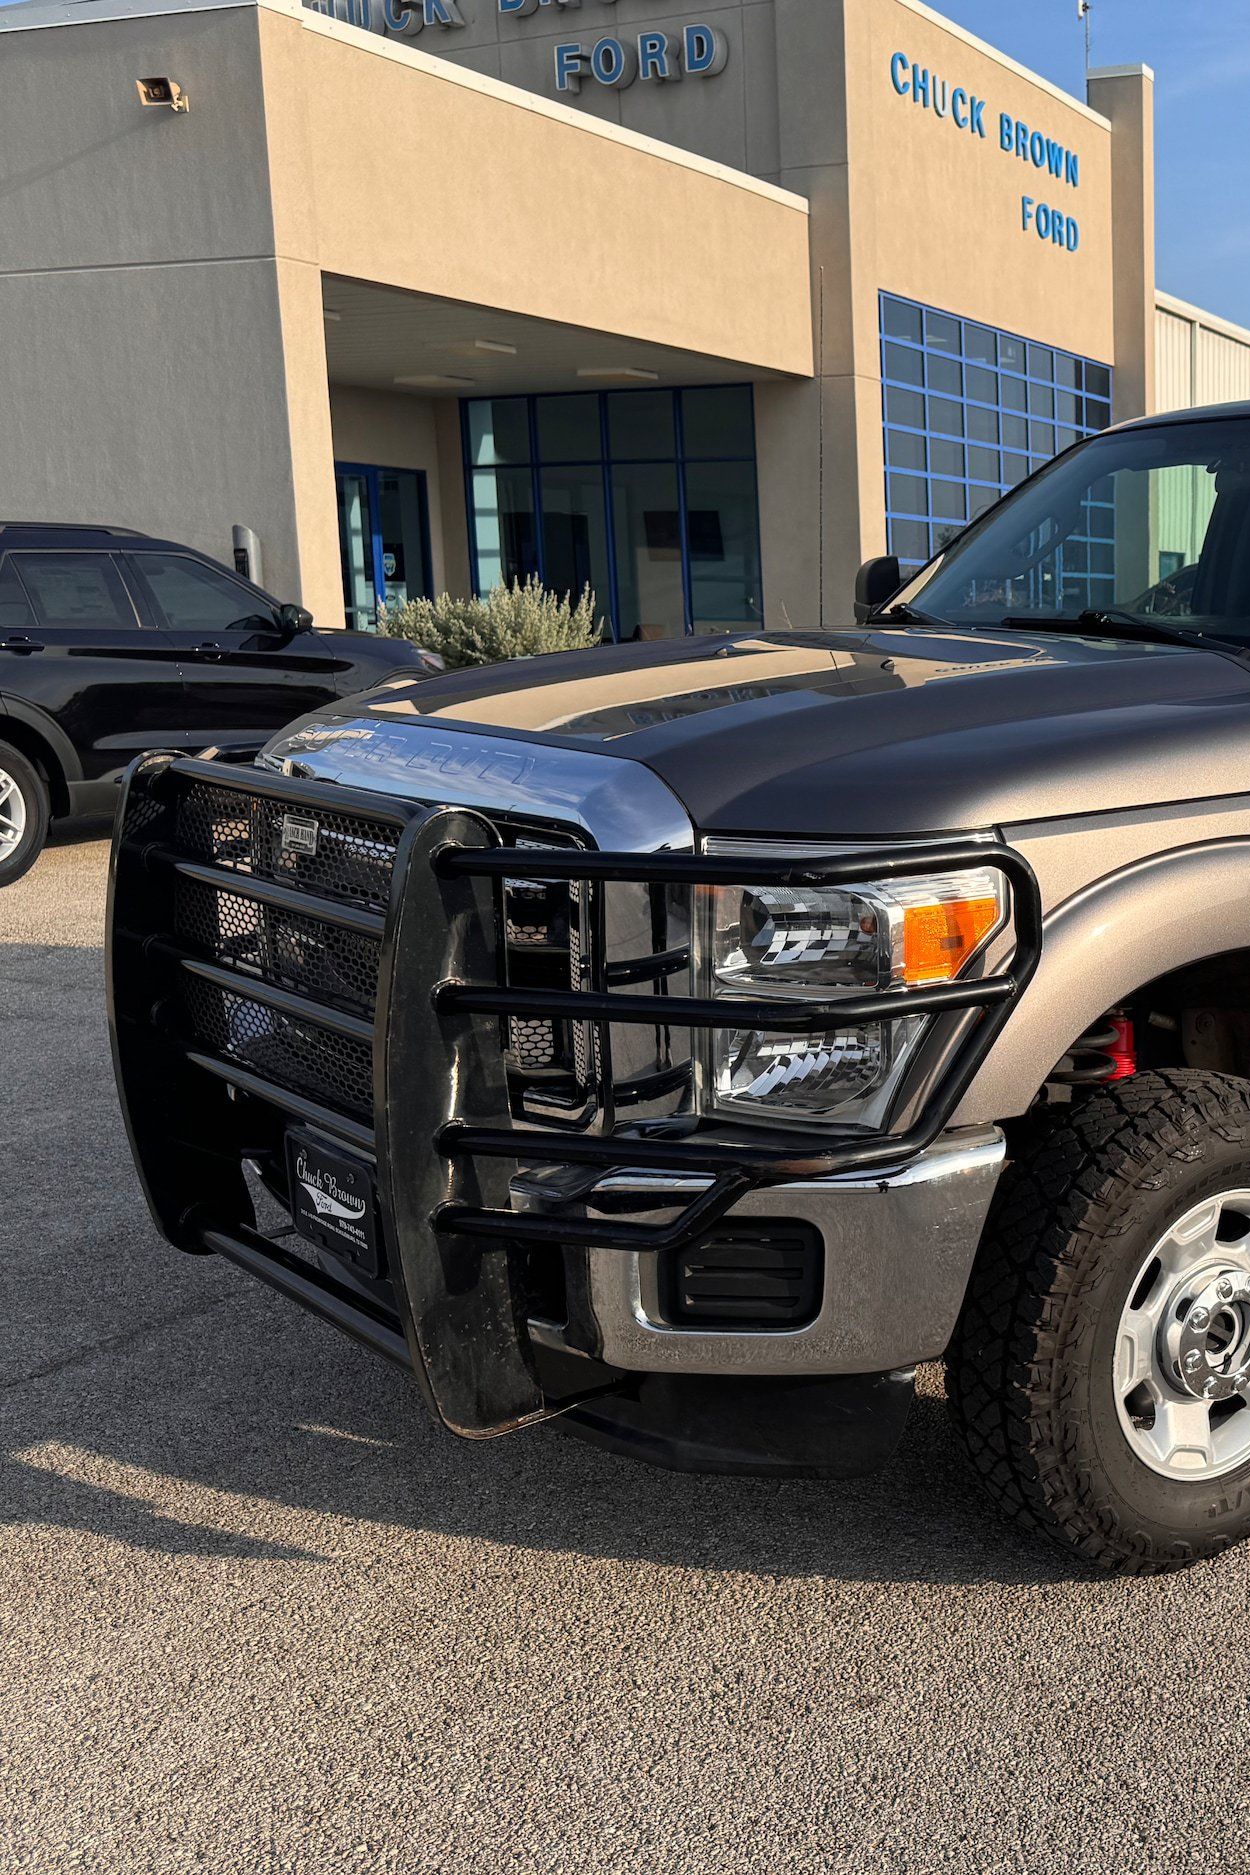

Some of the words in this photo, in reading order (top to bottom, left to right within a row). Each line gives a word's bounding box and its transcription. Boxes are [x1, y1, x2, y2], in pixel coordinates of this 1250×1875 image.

[554, 23, 716, 90] FORD
[890, 51, 986, 139] CHUCK
[1000, 112, 1079, 188] BROWN
[1021, 195, 1080, 252] FORD
[296, 1156, 323, 1190] Chuck
[323, 1172, 366, 1211] Brown
[316, 1192, 333, 1213] Ford
